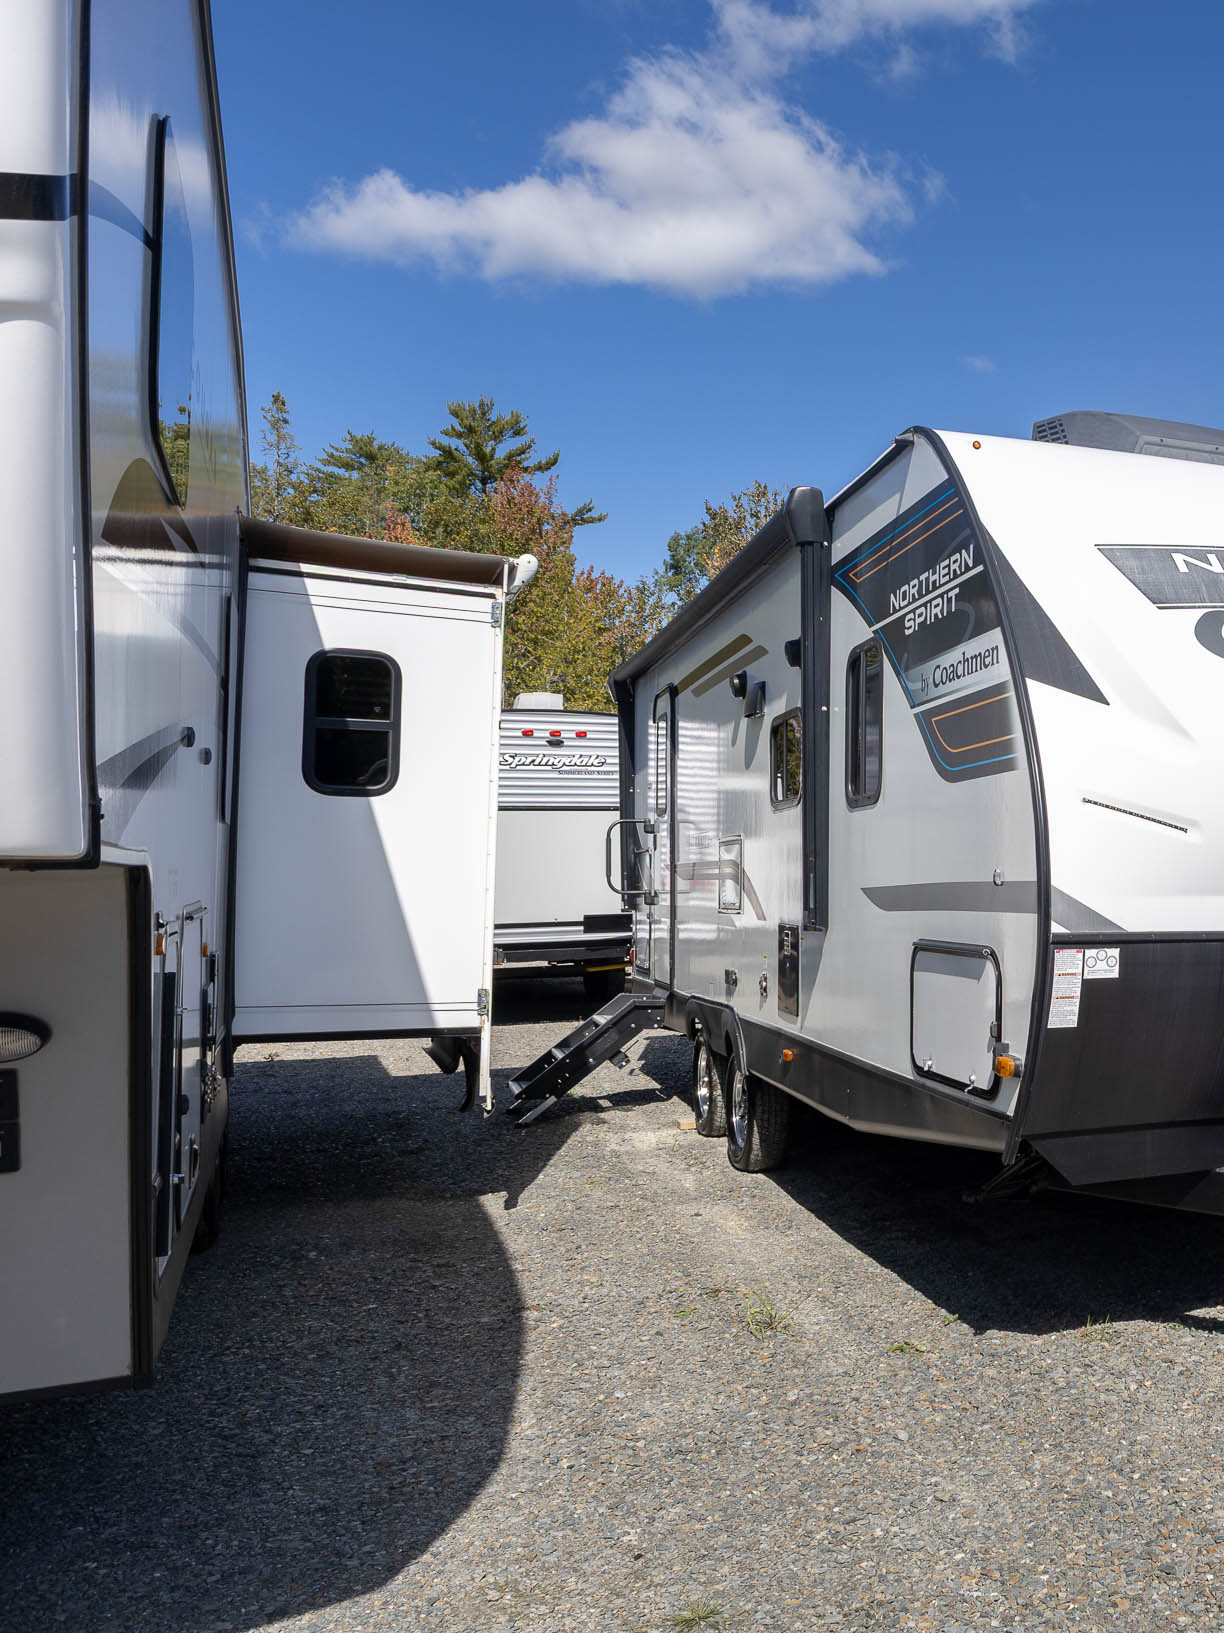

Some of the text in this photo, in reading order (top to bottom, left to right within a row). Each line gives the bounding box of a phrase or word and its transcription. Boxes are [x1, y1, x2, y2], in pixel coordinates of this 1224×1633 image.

[889, 544, 974, 613] NORTHERN
[904, 587, 960, 636] SPIRIT
[920, 643, 1001, 697] by Coachmen
[499, 752, 607, 770] Springdale
